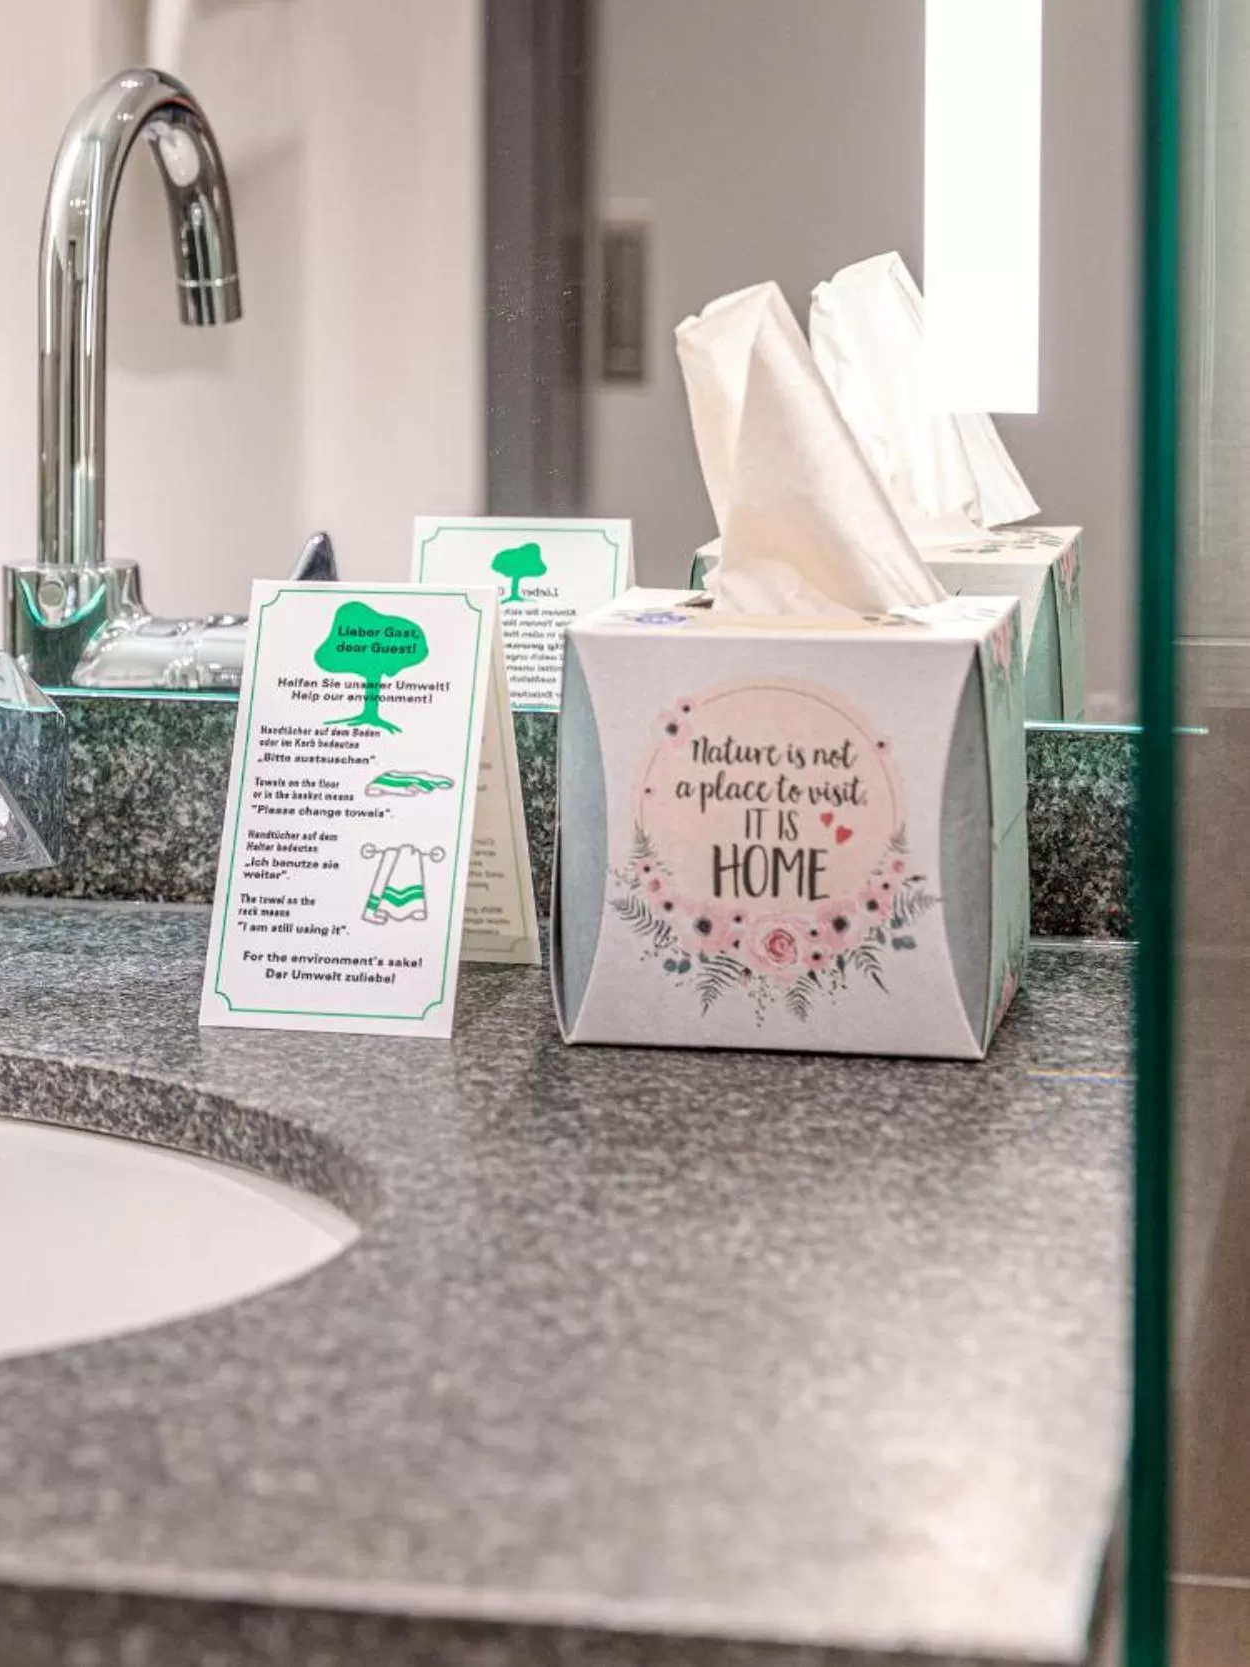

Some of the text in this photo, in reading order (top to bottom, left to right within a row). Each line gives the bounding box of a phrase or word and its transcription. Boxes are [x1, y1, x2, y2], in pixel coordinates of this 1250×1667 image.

[337, 626, 419, 639] Lieber Gast,
[336, 642, 417, 655] dear Guest!
[278, 678, 449, 691] Helfen Sie unserer Umwelt!
[291, 691, 320, 703] Help
[348, 692, 433, 703] environment!
[261, 726, 312, 736] Handtücher
[315, 728, 328, 736] auf
[352, 729, 380, 737] Boden
[281, 739, 292, 747] im
[295, 739, 315, 748] Korb
[318, 739, 359, 748] bedeuten
[692, 735, 858, 769] Nature is not
[255, 777, 340, 788] Towels on the floor
[265, 791, 272, 799] in
[276, 791, 289, 799] the
[292, 792, 322, 800] basket
[325, 793, 354, 801] means
[676, 780, 694, 799] a
[701, 770, 773, 814] place
[776, 774, 805, 804] to
[299, 806, 342, 817] change
[745, 809, 799, 841] IT IS
[248, 830, 337, 841] Handtücher auf dem
[247, 842, 318, 852] Halter bedeuten
[272, 858, 319, 868] benutze
[323, 861, 339, 869] sie
[713, 844, 830, 900] HOME
[240, 893, 256, 903] The
[260, 896, 284, 905] towel
[301, 896, 315, 905] the
[238, 908, 290, 917] rack means
[271, 924, 293, 933] still
[297, 925, 329, 936] using
[243, 951, 422, 968] For the environment's sake!
[265, 969, 395, 984] Der Umwelt zuliebe!
